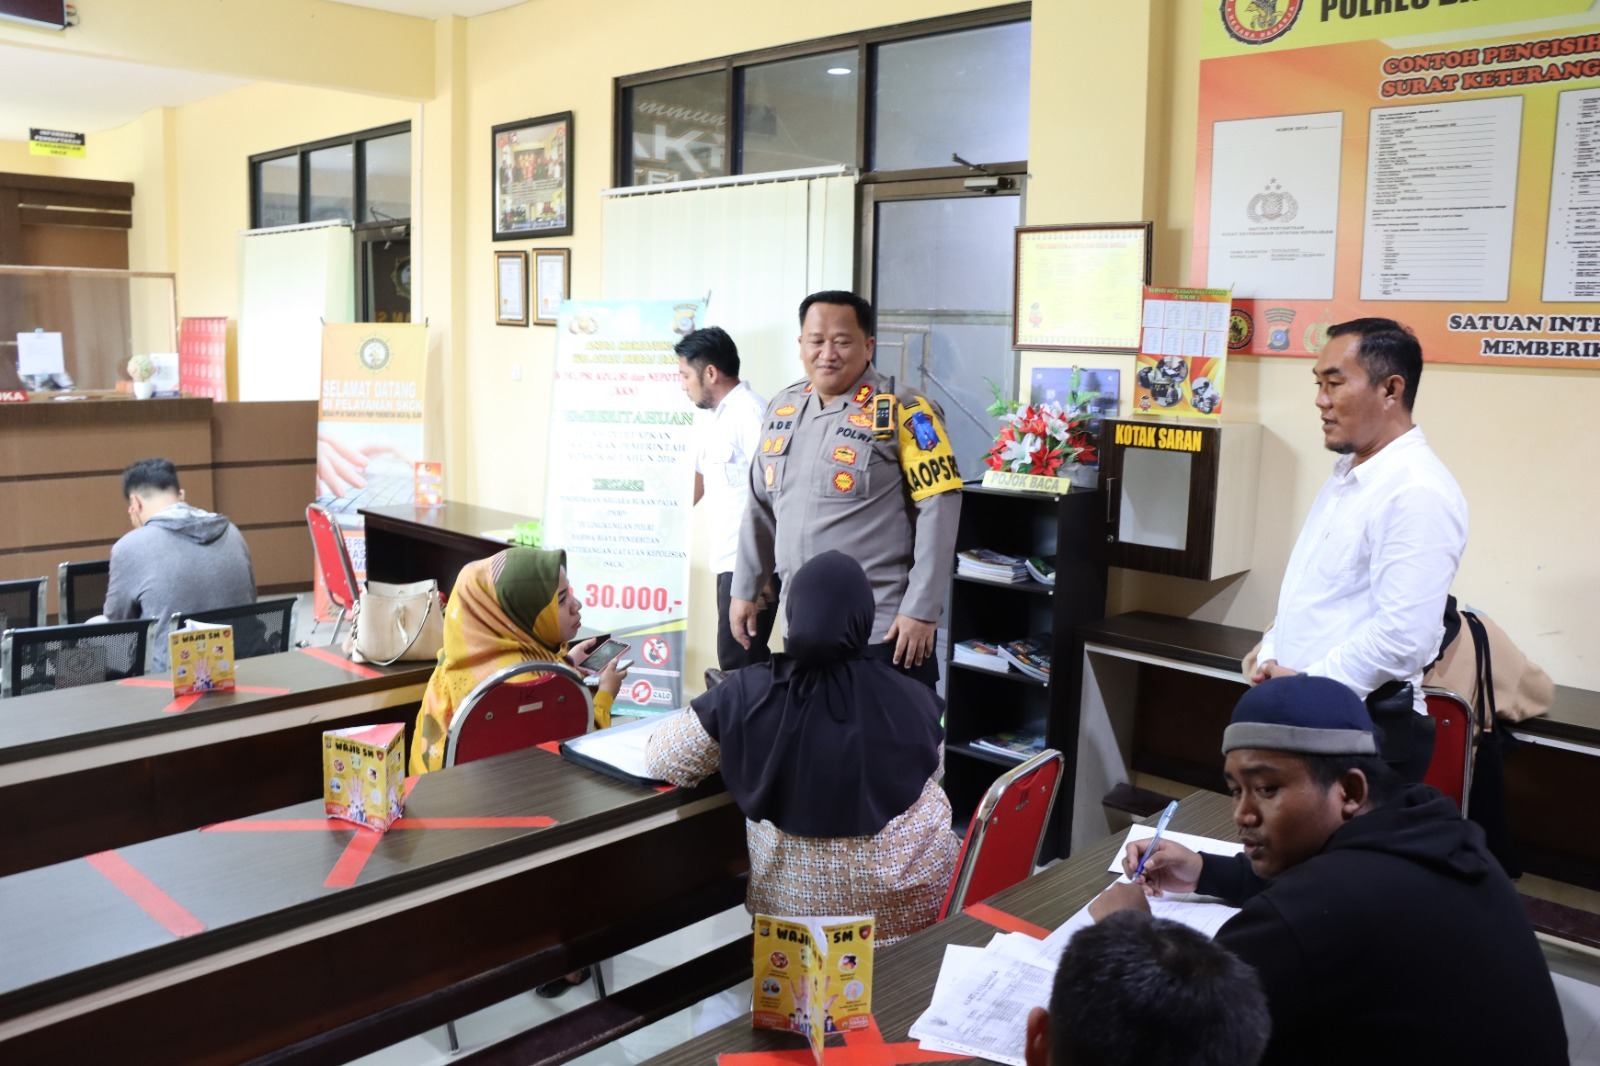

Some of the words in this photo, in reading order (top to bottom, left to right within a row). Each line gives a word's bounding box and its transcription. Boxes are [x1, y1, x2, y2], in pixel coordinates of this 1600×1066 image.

[1383, 48, 1480, 75] CONTOH
[1381, 73, 1459, 97] SURAT
[1462, 58, 1600, 91] KETERANG
[1449, 315, 1543, 331] SATUAN
[768, 421, 793, 431] ADE
[1115, 424, 1157, 447] KOTAK
[1158, 428, 1203, 452] SARAN
[991, 472, 1028, 488] POJOK
[1031, 477, 1060, 491] BACA
[585, 583, 682, 613] 30.000,-
